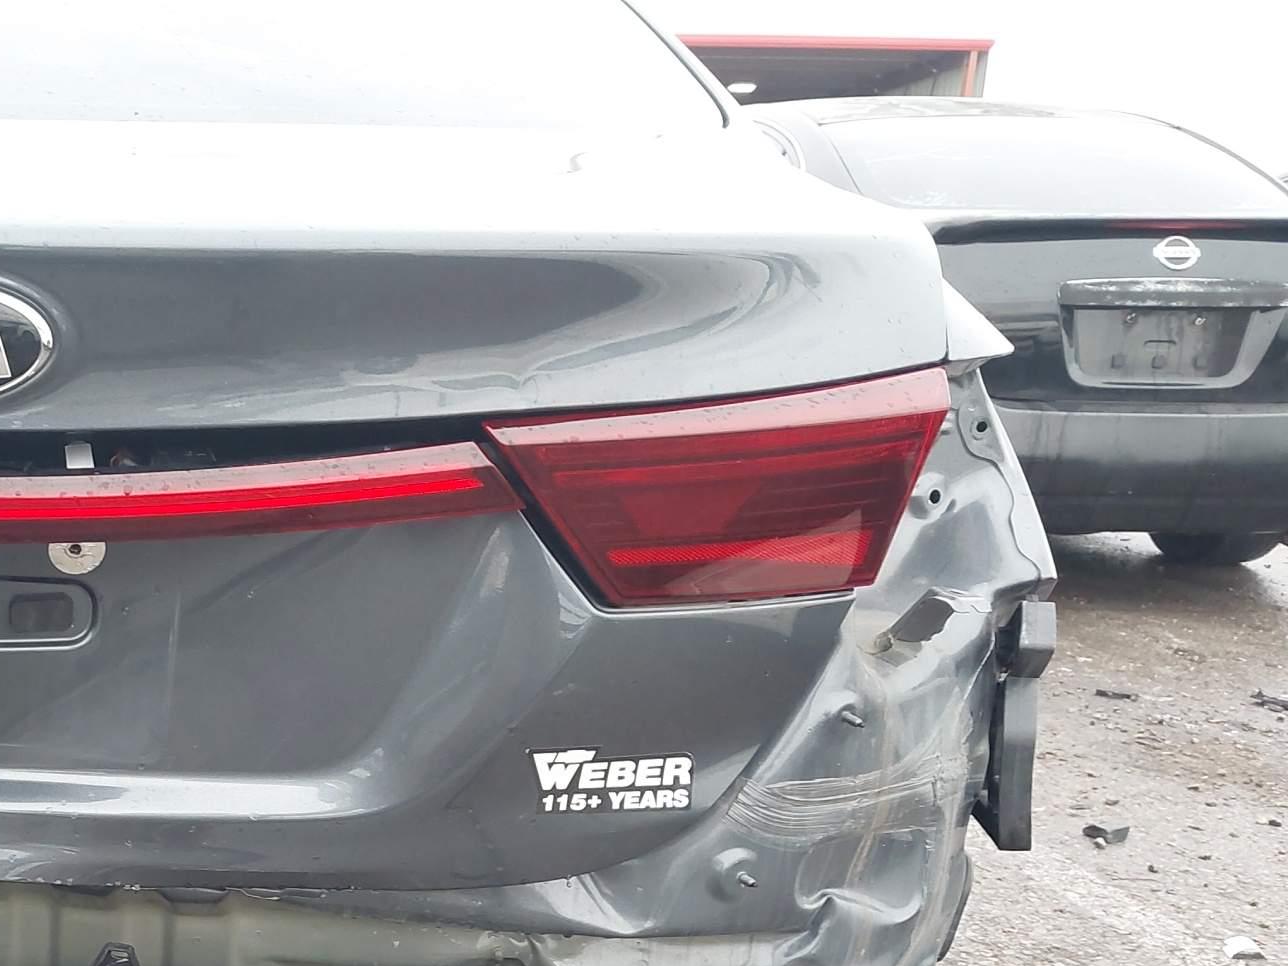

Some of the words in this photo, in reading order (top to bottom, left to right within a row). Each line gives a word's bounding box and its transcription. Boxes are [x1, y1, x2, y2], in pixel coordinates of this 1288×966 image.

[532, 750, 693, 791] WEBER
[542, 793, 602, 812] 115+
[608, 789, 690, 810] YEARS
